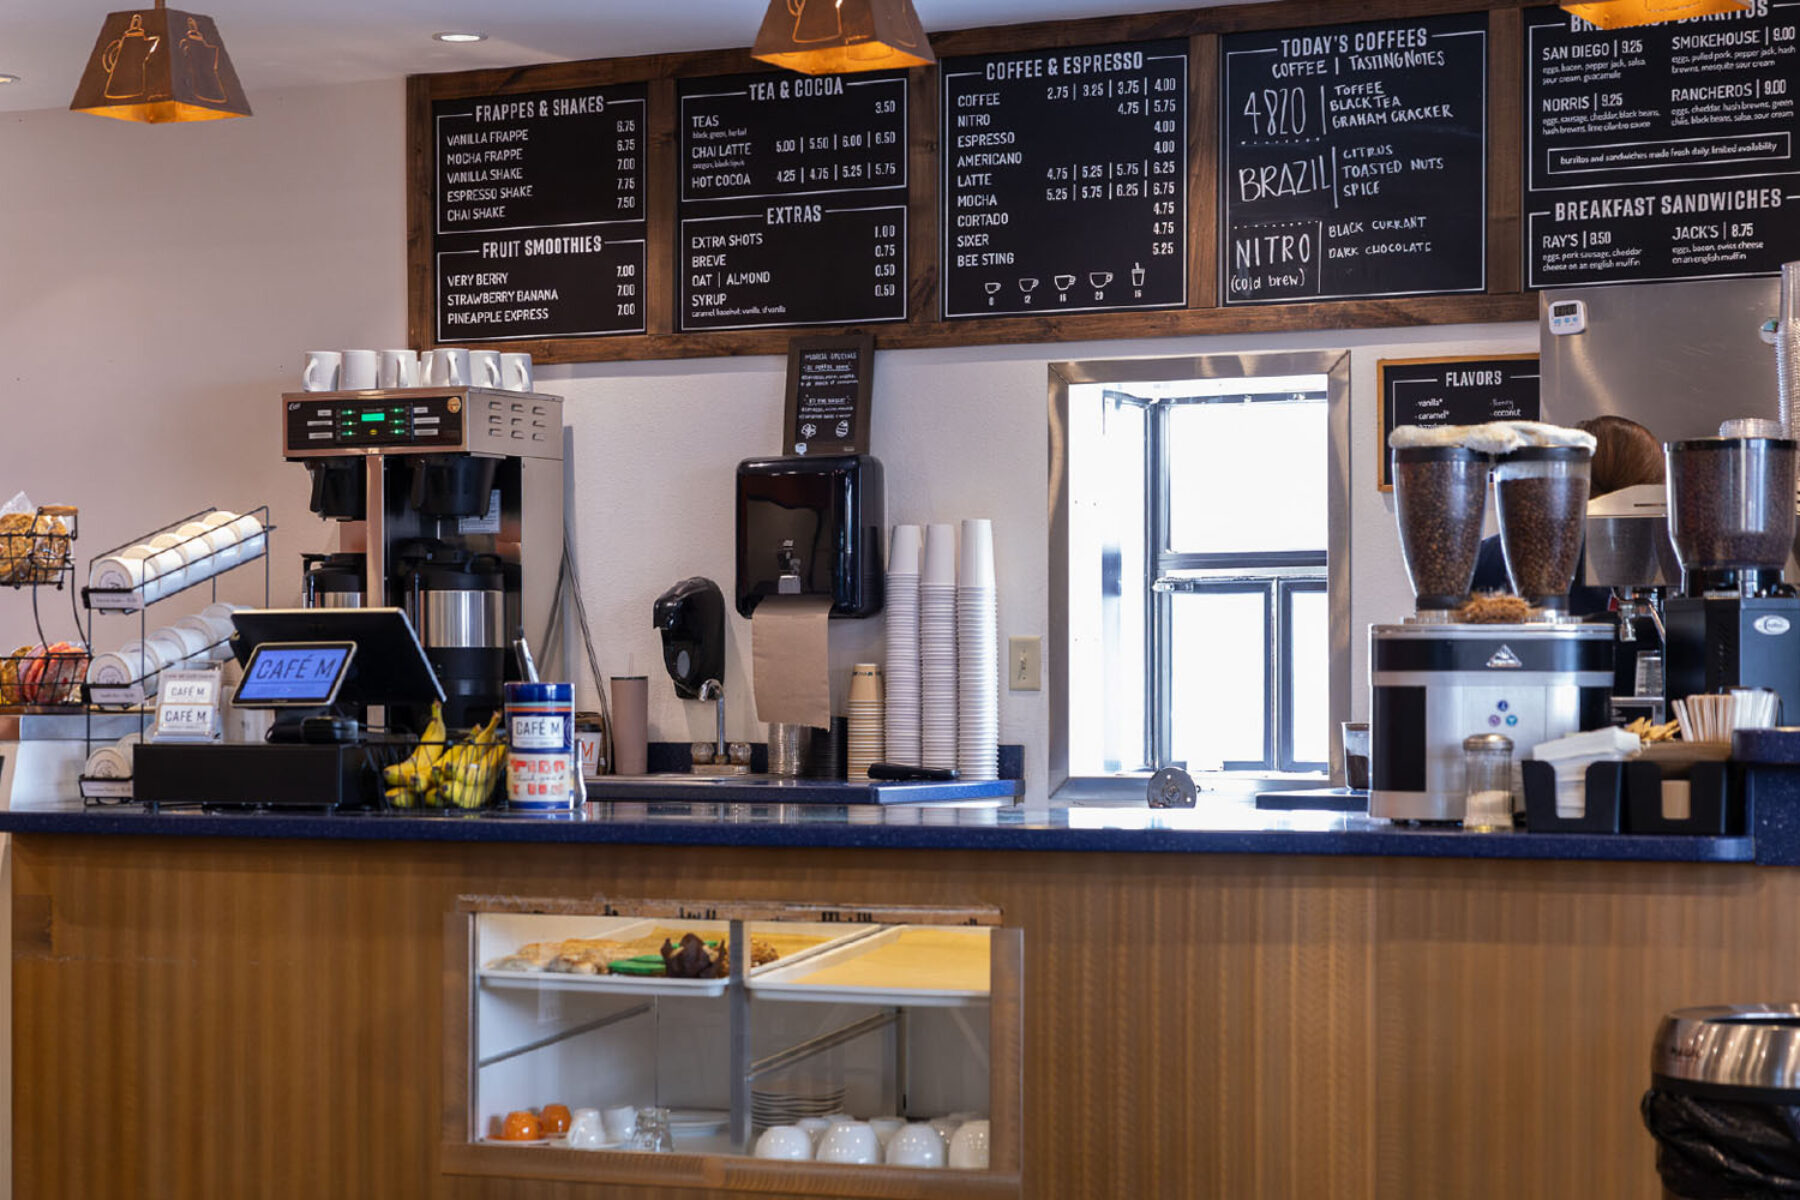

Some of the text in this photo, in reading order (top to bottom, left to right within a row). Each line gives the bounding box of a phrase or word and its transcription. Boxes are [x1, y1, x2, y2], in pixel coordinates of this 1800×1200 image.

[1281, 28, 1427, 57] TODAY'S COFFEES
[1672, 26, 1795, 50] SMOKEHOUSE 9.00
[1543, 46, 1568, 60] SAN
[1572, 43, 1610, 58] DIEGO
[986, 52, 1143, 80] COFFEE & ESPRESSO
[1272, 50, 1444, 78] COFFEE TASTING NOTES
[749, 77, 843, 101] TEA & COCOA
[1047, 78, 1176, 100] 2.75 3.25 3.75 4.00
[1335, 81, 1384, 96] TOFFEE
[1672, 79, 1786, 102] RANCHEROS 9.00
[875, 101, 895, 114] 3.50
[958, 93, 1000, 107] COFFEE
[1118, 100, 1176, 115] 4.75 5.75
[1330, 94, 1401, 110] BLACK TEA
[1543, 96, 1590, 112] NORRIS
[475, 96, 604, 122] FRAPPES & SHAKES
[1244, 87, 1306, 135] 4820
[1332, 104, 1453, 128] GRAHAM CRACKER
[692, 115, 719, 127] TEAS
[958, 114, 990, 127] NITRO
[1154, 120, 1175, 132] 4.00
[447, 129, 528, 147] VANILLA FRAPPE
[958, 132, 1015, 147] ESPRESSO
[692, 142, 752, 159] CHAI LATTE
[1154, 141, 1175, 153] 4.00
[1344, 145, 1392, 159] CITRUS
[447, 148, 523, 165] MOCHA FRAPPE
[958, 152, 1022, 167] AMERICANO
[1591, 154, 1603, 162] and
[447, 168, 523, 183] VANILLA SHAKE
[692, 163, 896, 188] HOT COCOA 4.25 4.75 5.25 5.75
[1047, 163, 1138, 180] 4.75 5.25 5.75
[1342, 158, 1444, 178] TOASTED NUTS
[958, 174, 992, 187] LATTE
[1239, 155, 1331, 202] BRAZIL
[447, 186, 533, 203] ESPRESSO SHAKE
[1343, 182, 1379, 197] SPICE
[617, 197, 635, 209] 7.50
[958, 195, 997, 207] MOCHA
[1153, 202, 1174, 215] 4.75
[1555, 188, 1782, 222] BREAKFAST SANDWICHES
[447, 206, 506, 222] CHAI SHAKE
[767, 205, 822, 225] EXTRAS
[958, 213, 1008, 227] CORTADO
[1153, 222, 1174, 235] 4.75
[1329, 216, 1426, 237] BLACK CURRANT
[1672, 223, 1753, 240] JACK'S 8.75
[483, 236, 602, 258] FRUIT SMOOTHIES
[692, 233, 763, 249] EXTRA SHOTS
[958, 234, 989, 247] SIXER
[1543, 234, 1578, 248] RAY'S
[1738, 241, 1764, 249] cheese
[875, 245, 895, 257] 0.75
[1153, 243, 1174, 255] 5.25
[1236, 234, 1310, 269] NITRO
[1329, 242, 1431, 258] DARK CHOCOLATE
[1612, 248, 1642, 257] cheddar
[692, 254, 726, 267] BREVE
[958, 253, 1014, 267] BEE STING
[447, 272, 508, 287] VERY BERRY
[692, 272, 770, 287] OAT ALMOND
[1231, 268, 1304, 292] (cold brew)
[448, 289, 558, 306] STRAWBERRY BANANA
[692, 294, 726, 306] SYRUP
[448, 308, 549, 324] PINEAPPLE EXPRESS
[1446, 371, 1502, 387] FLAVORS
[256, 655, 337, 680] CAFÉ M
[166, 708, 206, 722] CAFÉ M
[516, 719, 559, 736] CAFÉ M
